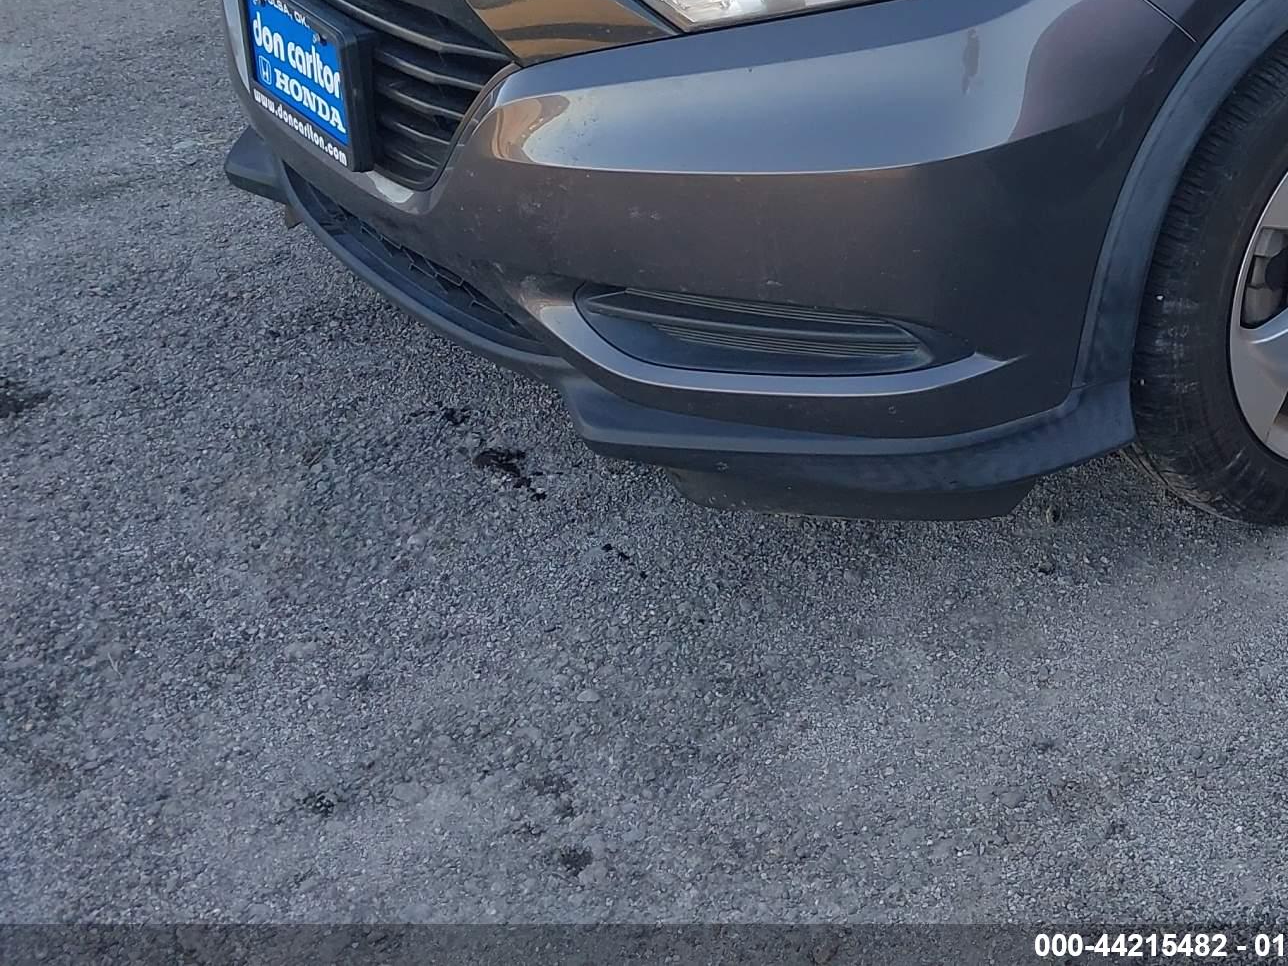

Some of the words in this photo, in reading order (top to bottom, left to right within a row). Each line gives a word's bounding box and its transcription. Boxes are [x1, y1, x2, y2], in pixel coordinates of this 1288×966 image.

[252, 11, 285, 61] don
[253, 88, 347, 166] www.doncarlton.com
[274, 67, 346, 133] HONDA
